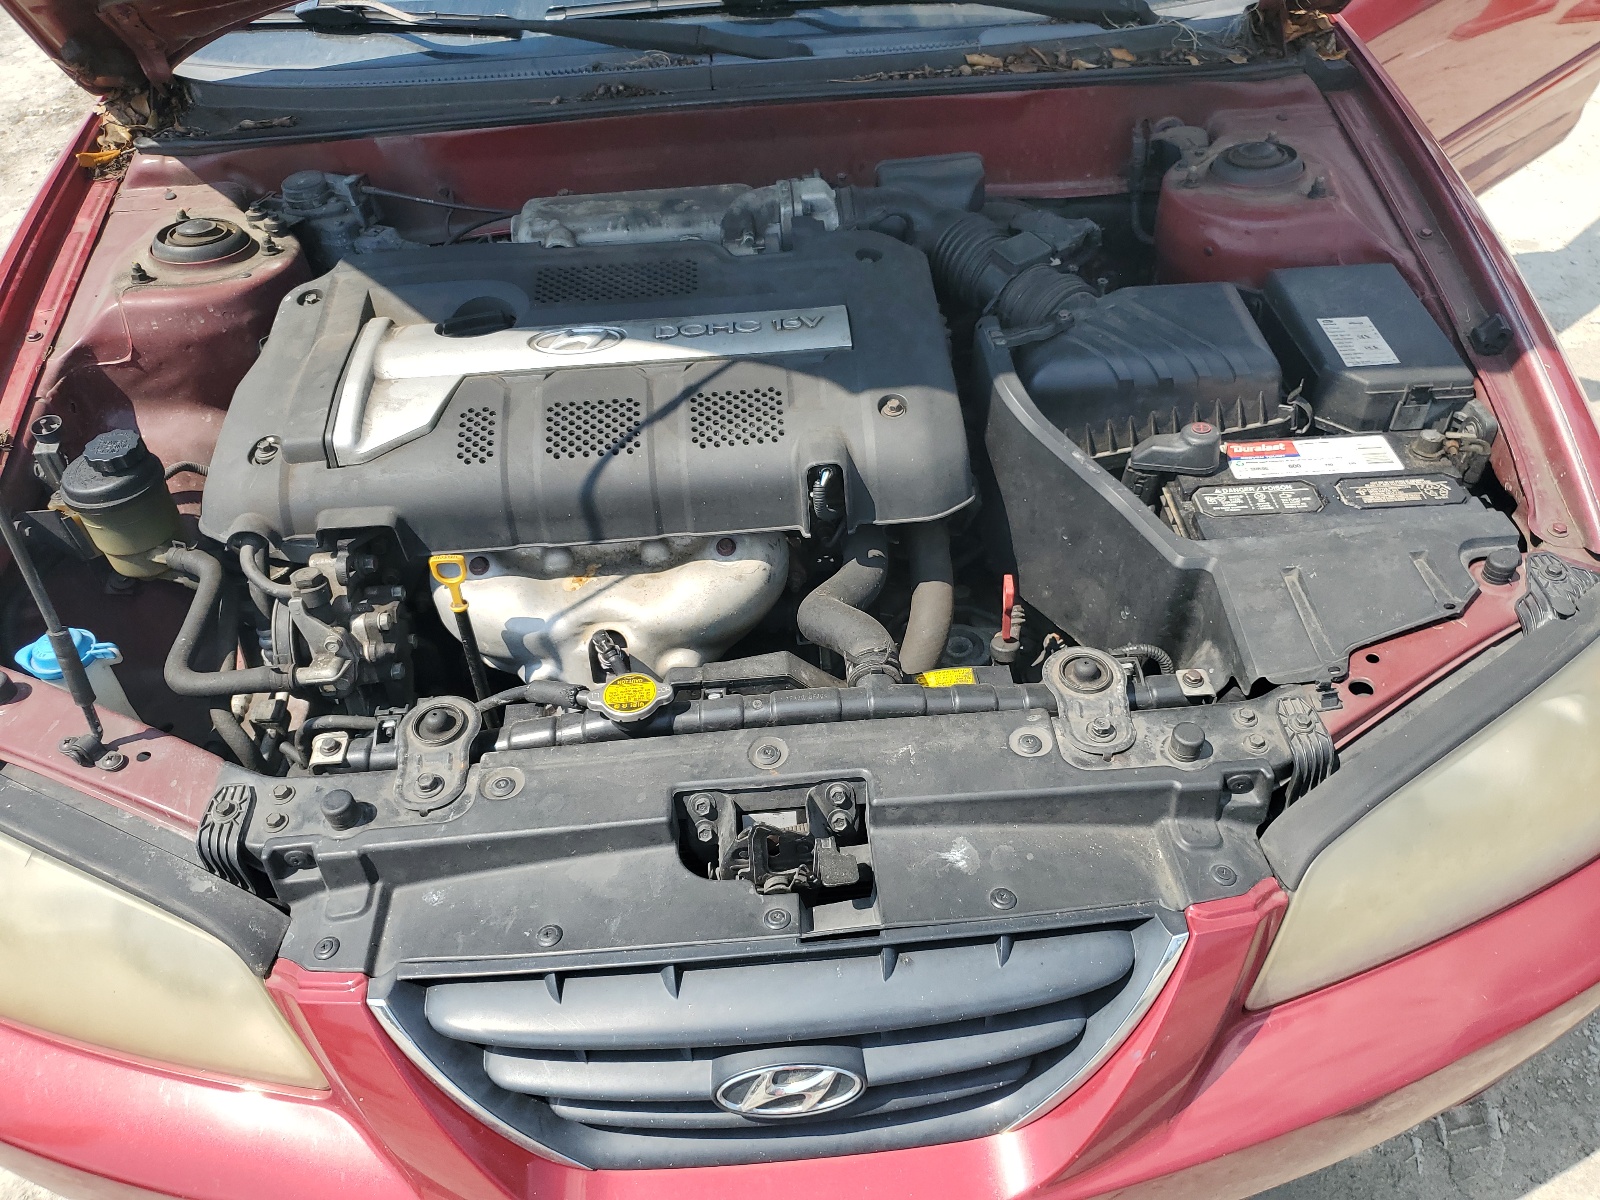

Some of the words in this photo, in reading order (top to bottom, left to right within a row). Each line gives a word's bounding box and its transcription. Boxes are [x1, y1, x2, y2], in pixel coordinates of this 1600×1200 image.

[654, 320, 762, 340] DOHC
[772, 315, 825, 331] 16V
[1229, 442, 1286, 453] Duralast
[1262, 484, 1293, 492] POISON
